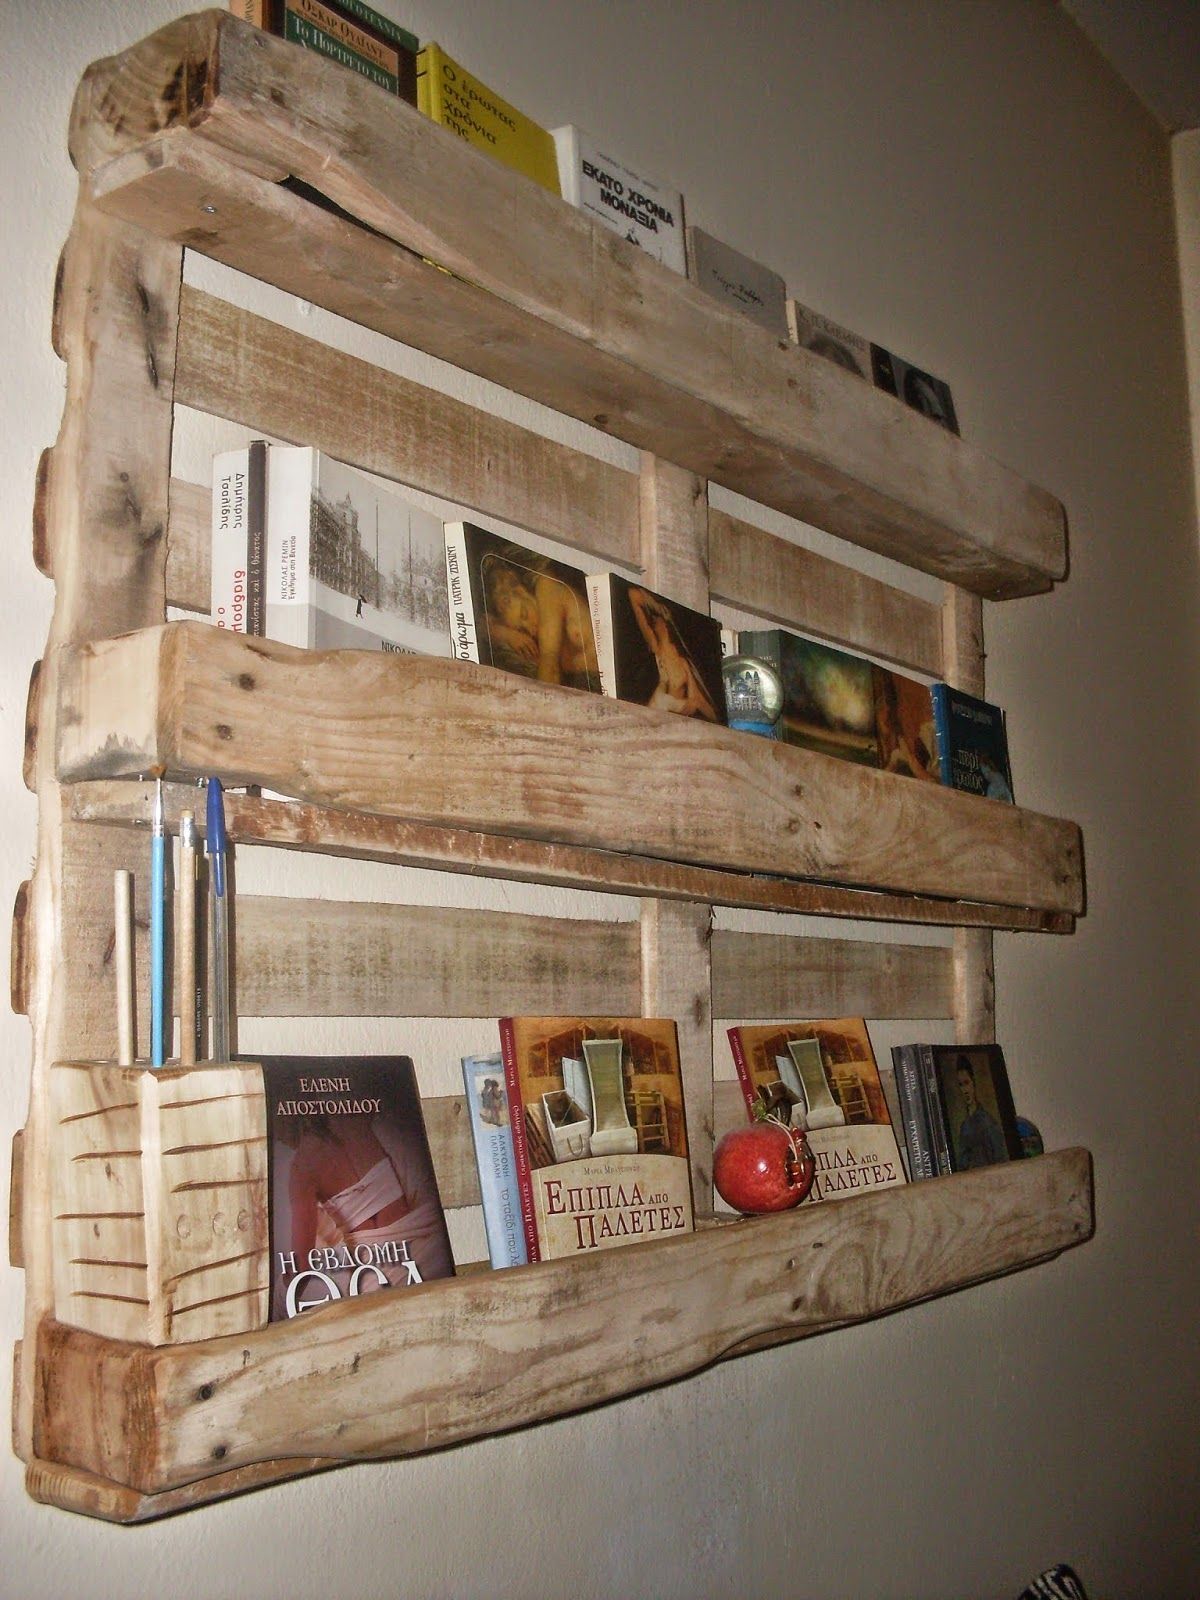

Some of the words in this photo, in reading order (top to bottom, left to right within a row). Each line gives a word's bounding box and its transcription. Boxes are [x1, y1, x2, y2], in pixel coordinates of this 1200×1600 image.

[443, 65, 456, 81] Ο
[444, 84, 470, 110] στα
[443, 98, 496, 145] χρόνια
[444, 113, 469, 142] της
[582, 159, 624, 196] ΕΚΑΤΟ
[628, 187, 675, 228] ΧΡΟΝΙΑ
[600, 187, 659, 234] ΜΟΝΑΞΙΑ
[219, 476, 231, 530] Τσαλίδης
[233, 473, 245, 529] Δημήτρης
[447, 545, 459, 574] ΖΙΣΚΙΝΤ
[450, 575, 462, 606] ΠΑΤΡΙΚ
[218, 607, 225, 615] ο
[455, 612, 474, 649] άρωμα
[381, 640, 416, 655] ΝΙΚΟΛ
[299, 1078, 351, 1093] ΕΛΕΝΗ
[277, 1098, 381, 1117] ΑΠΟΣΤΟΛΙΔΟΥ
[490, 1135, 501, 1179] ΠΑΠΑΔΑΚΗ
[497, 1134, 511, 1178] ΑΛΚΥΟΝΗ
[813, 1147, 858, 1172] ΠΛΑ
[861, 1153, 878, 1165] ΑΠΟ
[543, 1180, 645, 1215] ΕΠΙΠΛΑ
[648, 1193, 669, 1206] ΑΠΟ
[809, 1162, 897, 1202] ΠΑΛΕΤΕΣ
[502, 1202, 516, 1232] ταξίδι
[573, 1205, 686, 1250] ΠΑΛΕΤΕΣ
[278, 1251, 297, 1275] Η
[308, 1240, 411, 1272] ΕΒΔΟΜΗ
[507, 1233, 518, 1253] που
